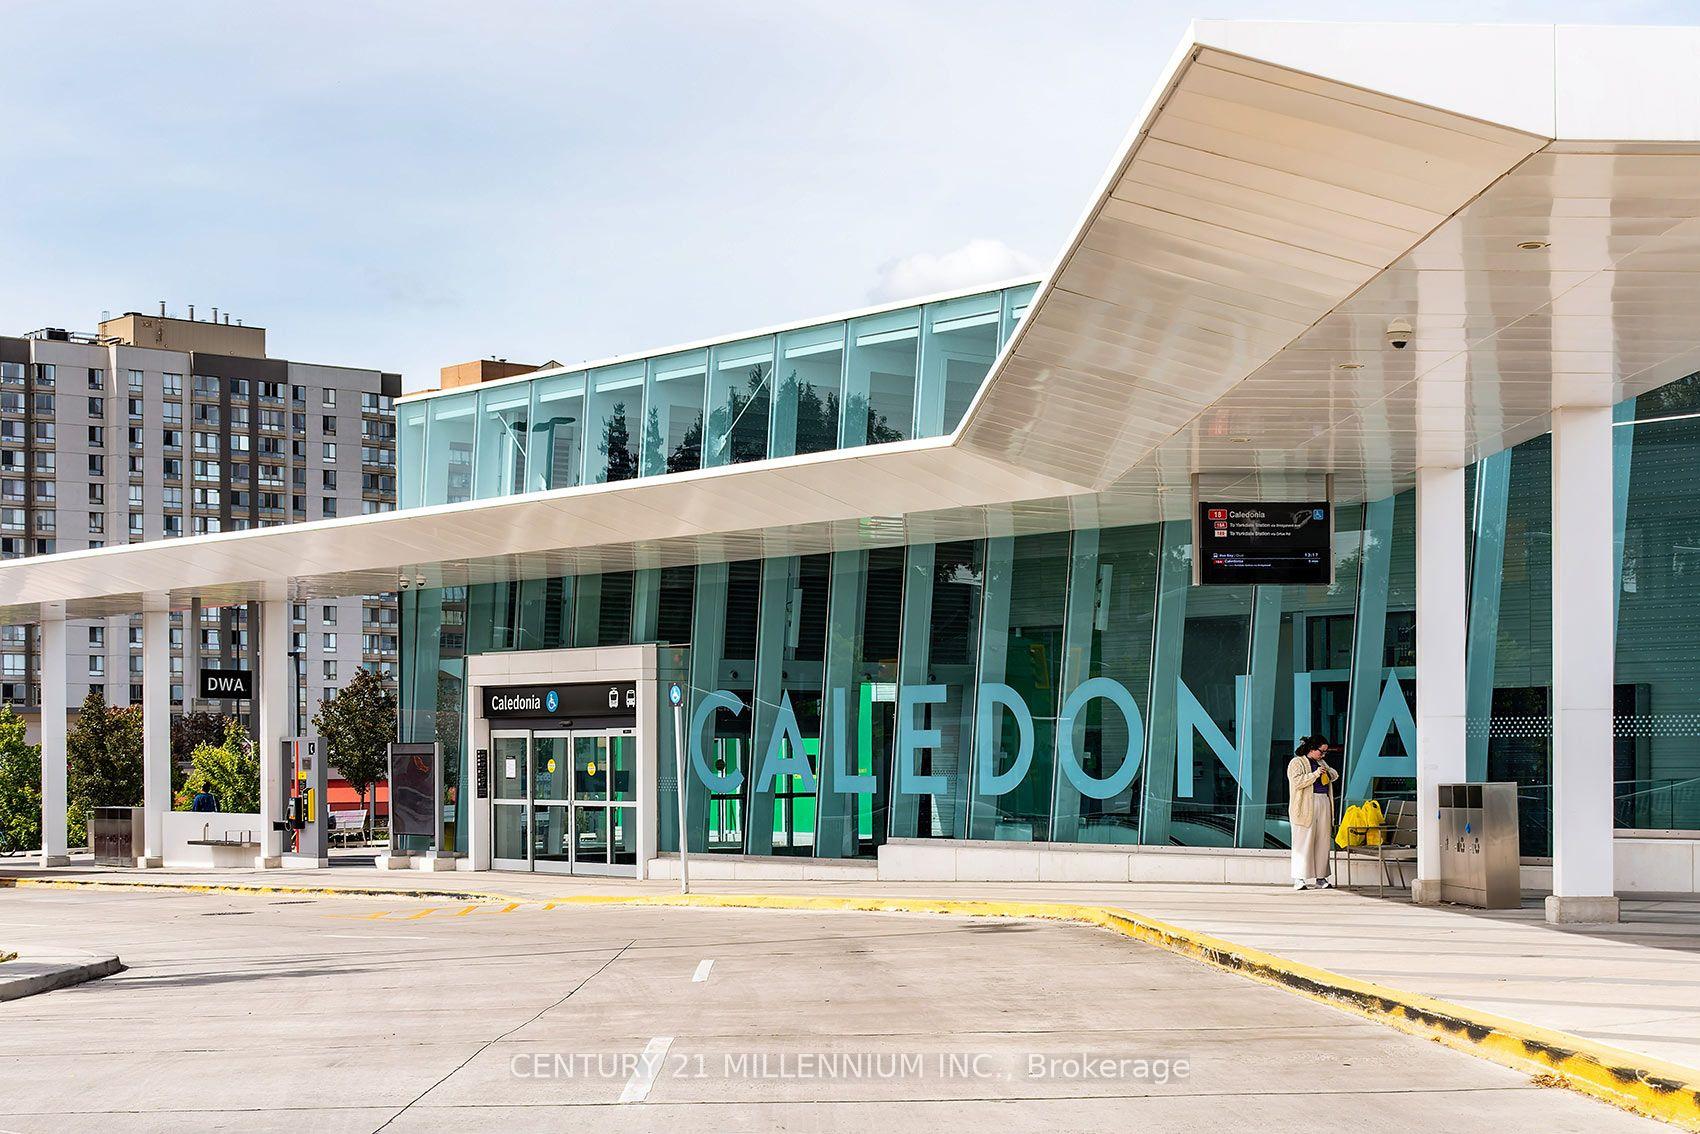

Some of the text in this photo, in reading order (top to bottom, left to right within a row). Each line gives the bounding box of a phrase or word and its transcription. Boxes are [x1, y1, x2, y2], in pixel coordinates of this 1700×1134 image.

[207, 677, 244, 692] DWA
[491, 695, 541, 711] Caledonia
[691, 667, 1416, 801] CALEDONIA
